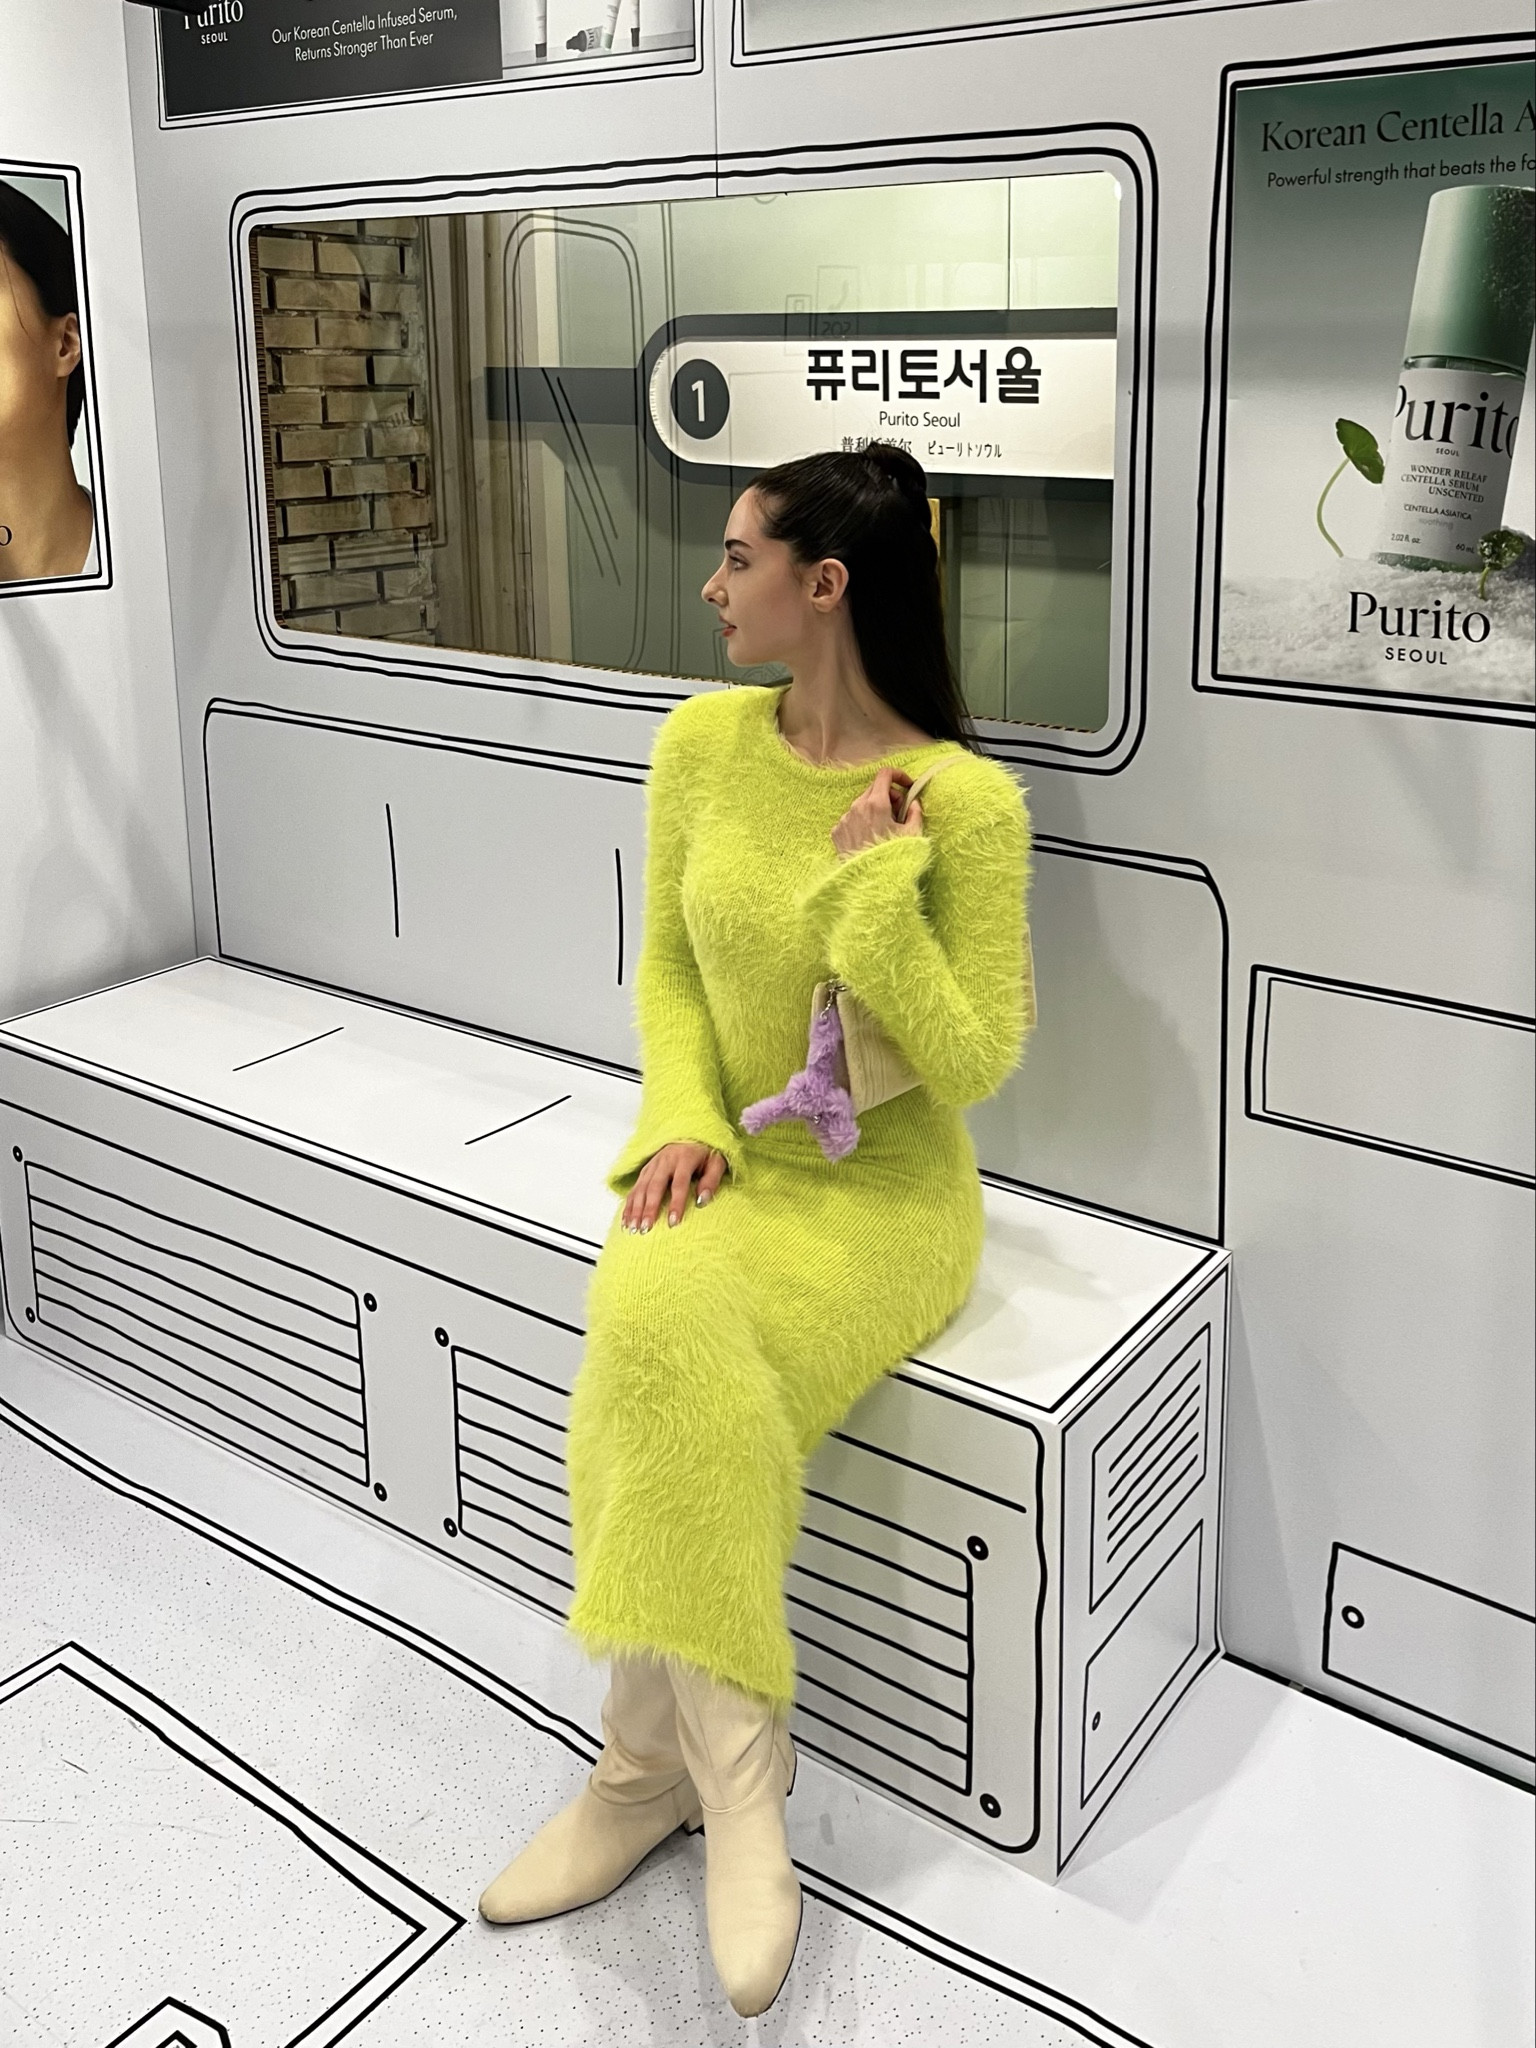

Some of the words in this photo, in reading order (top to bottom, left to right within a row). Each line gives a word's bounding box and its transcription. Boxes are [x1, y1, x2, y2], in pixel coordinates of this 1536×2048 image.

[272, 28, 292, 44] Our
[293, 26, 330, 41] Korean
[332, 15, 375, 36] Centella
[378, 8, 416, 29] Infused
[419, 7, 457, 23] Serum,
[201, 31, 228, 45] SEOUL
[295, 46, 332, 62] Returns
[333, 40, 378, 58] Stronger
[380, 33, 407, 51] Than
[410, 30, 434, 47] Ever
[1262, 121, 1366, 151] Korean
[1376, 101, 1504, 143] Centella
[1267, 168, 1332, 187] Powerful
[1335, 163, 1399, 186] strength
[1403, 160, 1436, 179] that
[1439, 159, 1485, 177] beats
[1490, 155, 1516, 173] the
[807, 346, 1042, 404] 퓨리토서울
[691, 380, 706, 422] 1
[879, 411, 919, 427] Purito
[923, 412, 961, 428] Seoul
[841, 436, 912, 454] 普利尔
[1435, 447, 1460, 457] SEOUL
[1411, 464, 1452, 477] WONDER
[1454, 469, 1488, 483] RELEAF
[1401, 474, 1446, 486] CENTELLA
[1448, 479, 1479, 492] SERUM
[1428, 486, 1485, 503] UNSCENTED
[1404, 503, 1439, 515] CENTELLA
[1440, 509, 1473, 521] ASIATICA
[1347, 591, 1491, 643] Purito
[1384, 647, 1448, 665] SEOUL
